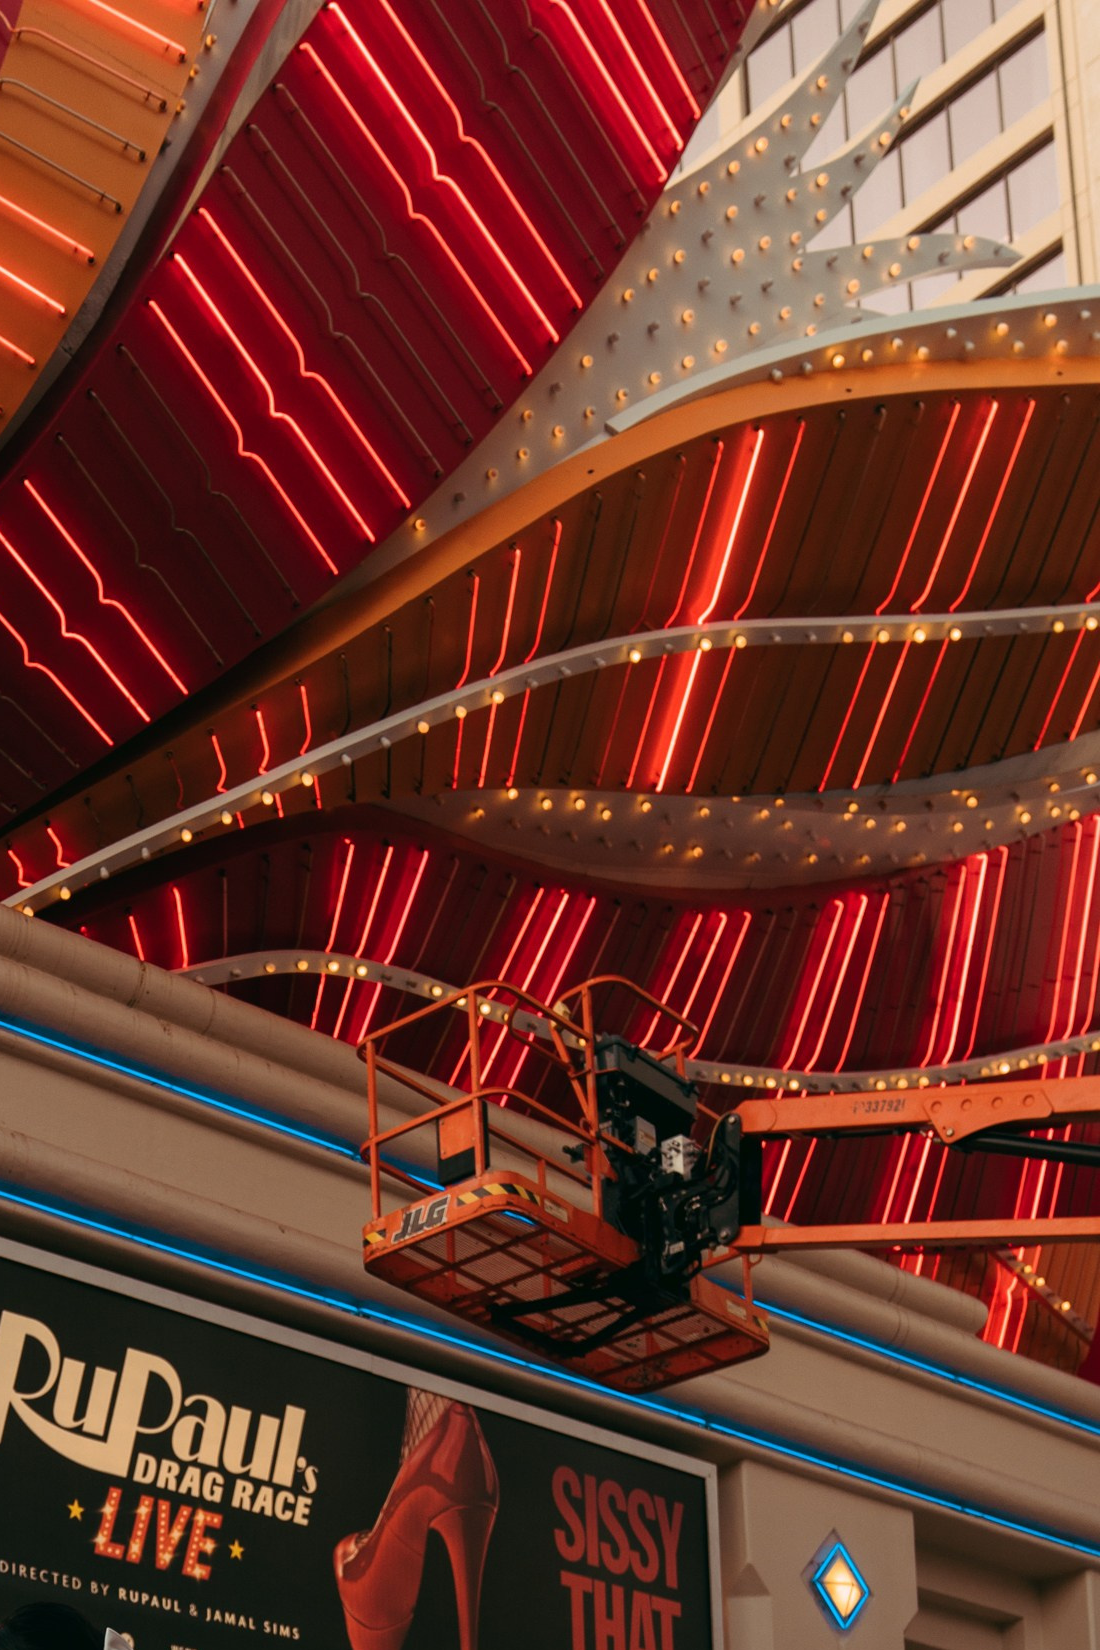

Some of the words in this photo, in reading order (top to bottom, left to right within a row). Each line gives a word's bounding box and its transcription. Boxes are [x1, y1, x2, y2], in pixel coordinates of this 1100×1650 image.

[391, 1194, 451, 1244] JLG
[133, 1452, 224, 1504] DRAG
[231, 1478, 313, 1527] RACE
[552, 1465, 684, 1589] SISSY
[92, 1486, 224, 1581] LIVE
[0, 1559, 82, 1591] DIRECTED
[90, 1581, 110, 1597] BY
[118, 1587, 181, 1614] RUPAUL
[188, 1603, 199, 1618] &
[205, 1607, 256, 1631] JAMAL
[263, 1621, 300, 1641] SIMS
